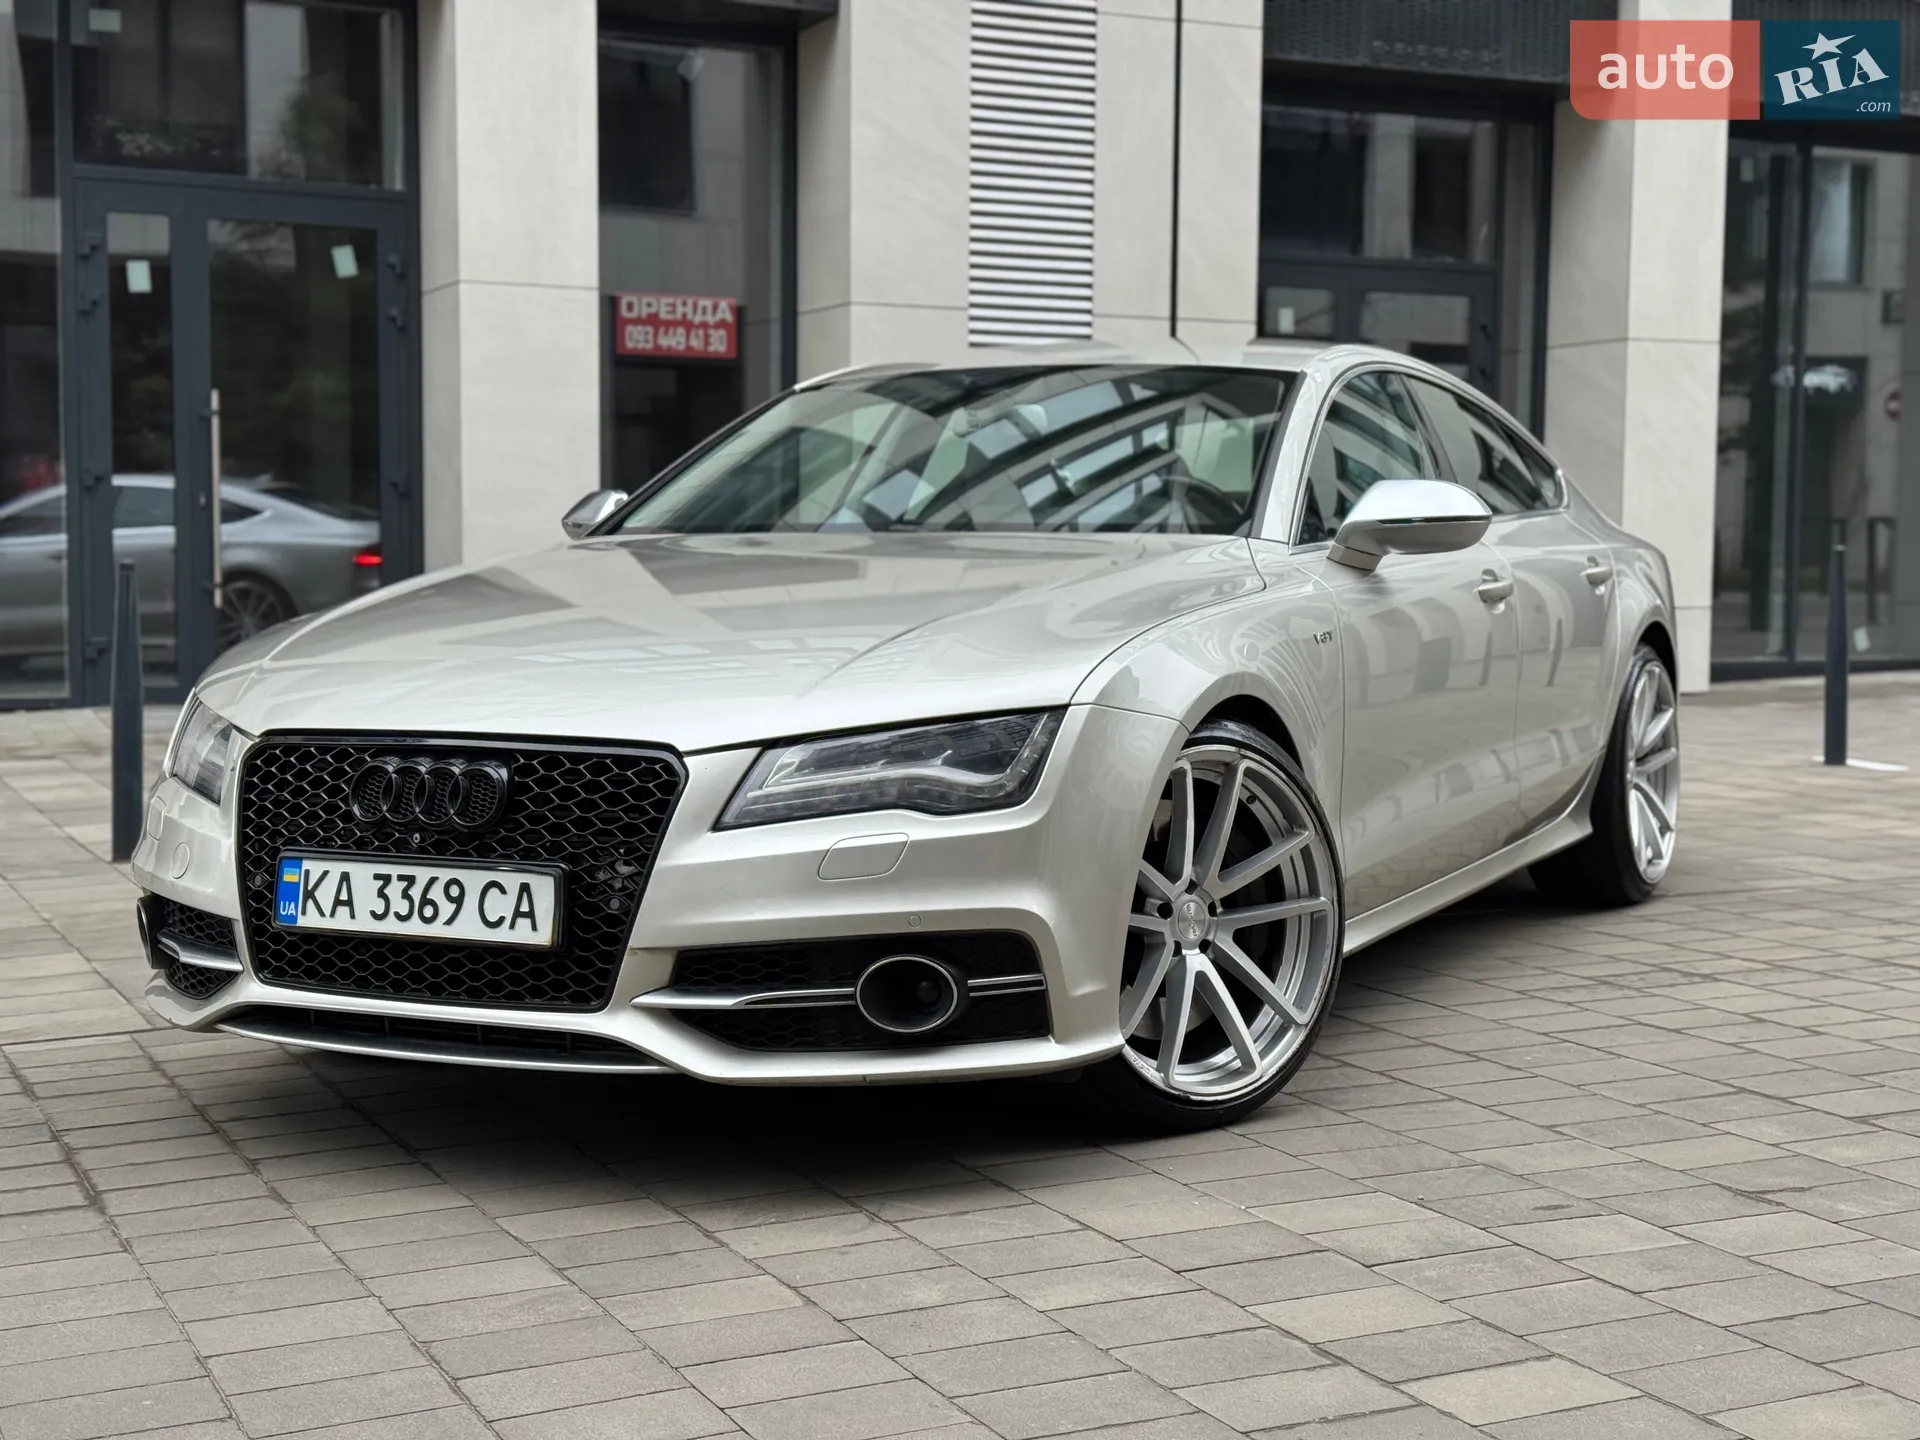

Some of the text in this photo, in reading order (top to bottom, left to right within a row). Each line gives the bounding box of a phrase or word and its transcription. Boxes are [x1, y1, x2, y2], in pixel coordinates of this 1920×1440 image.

[621, 296, 733, 325] ОРЕНДА
[624, 324, 654, 350] 093
[688, 328, 705, 351] 41
[707, 328, 728, 352] 30
[279, 900, 296, 916] UA
[300, 868, 538, 932] KA 3369 CA
